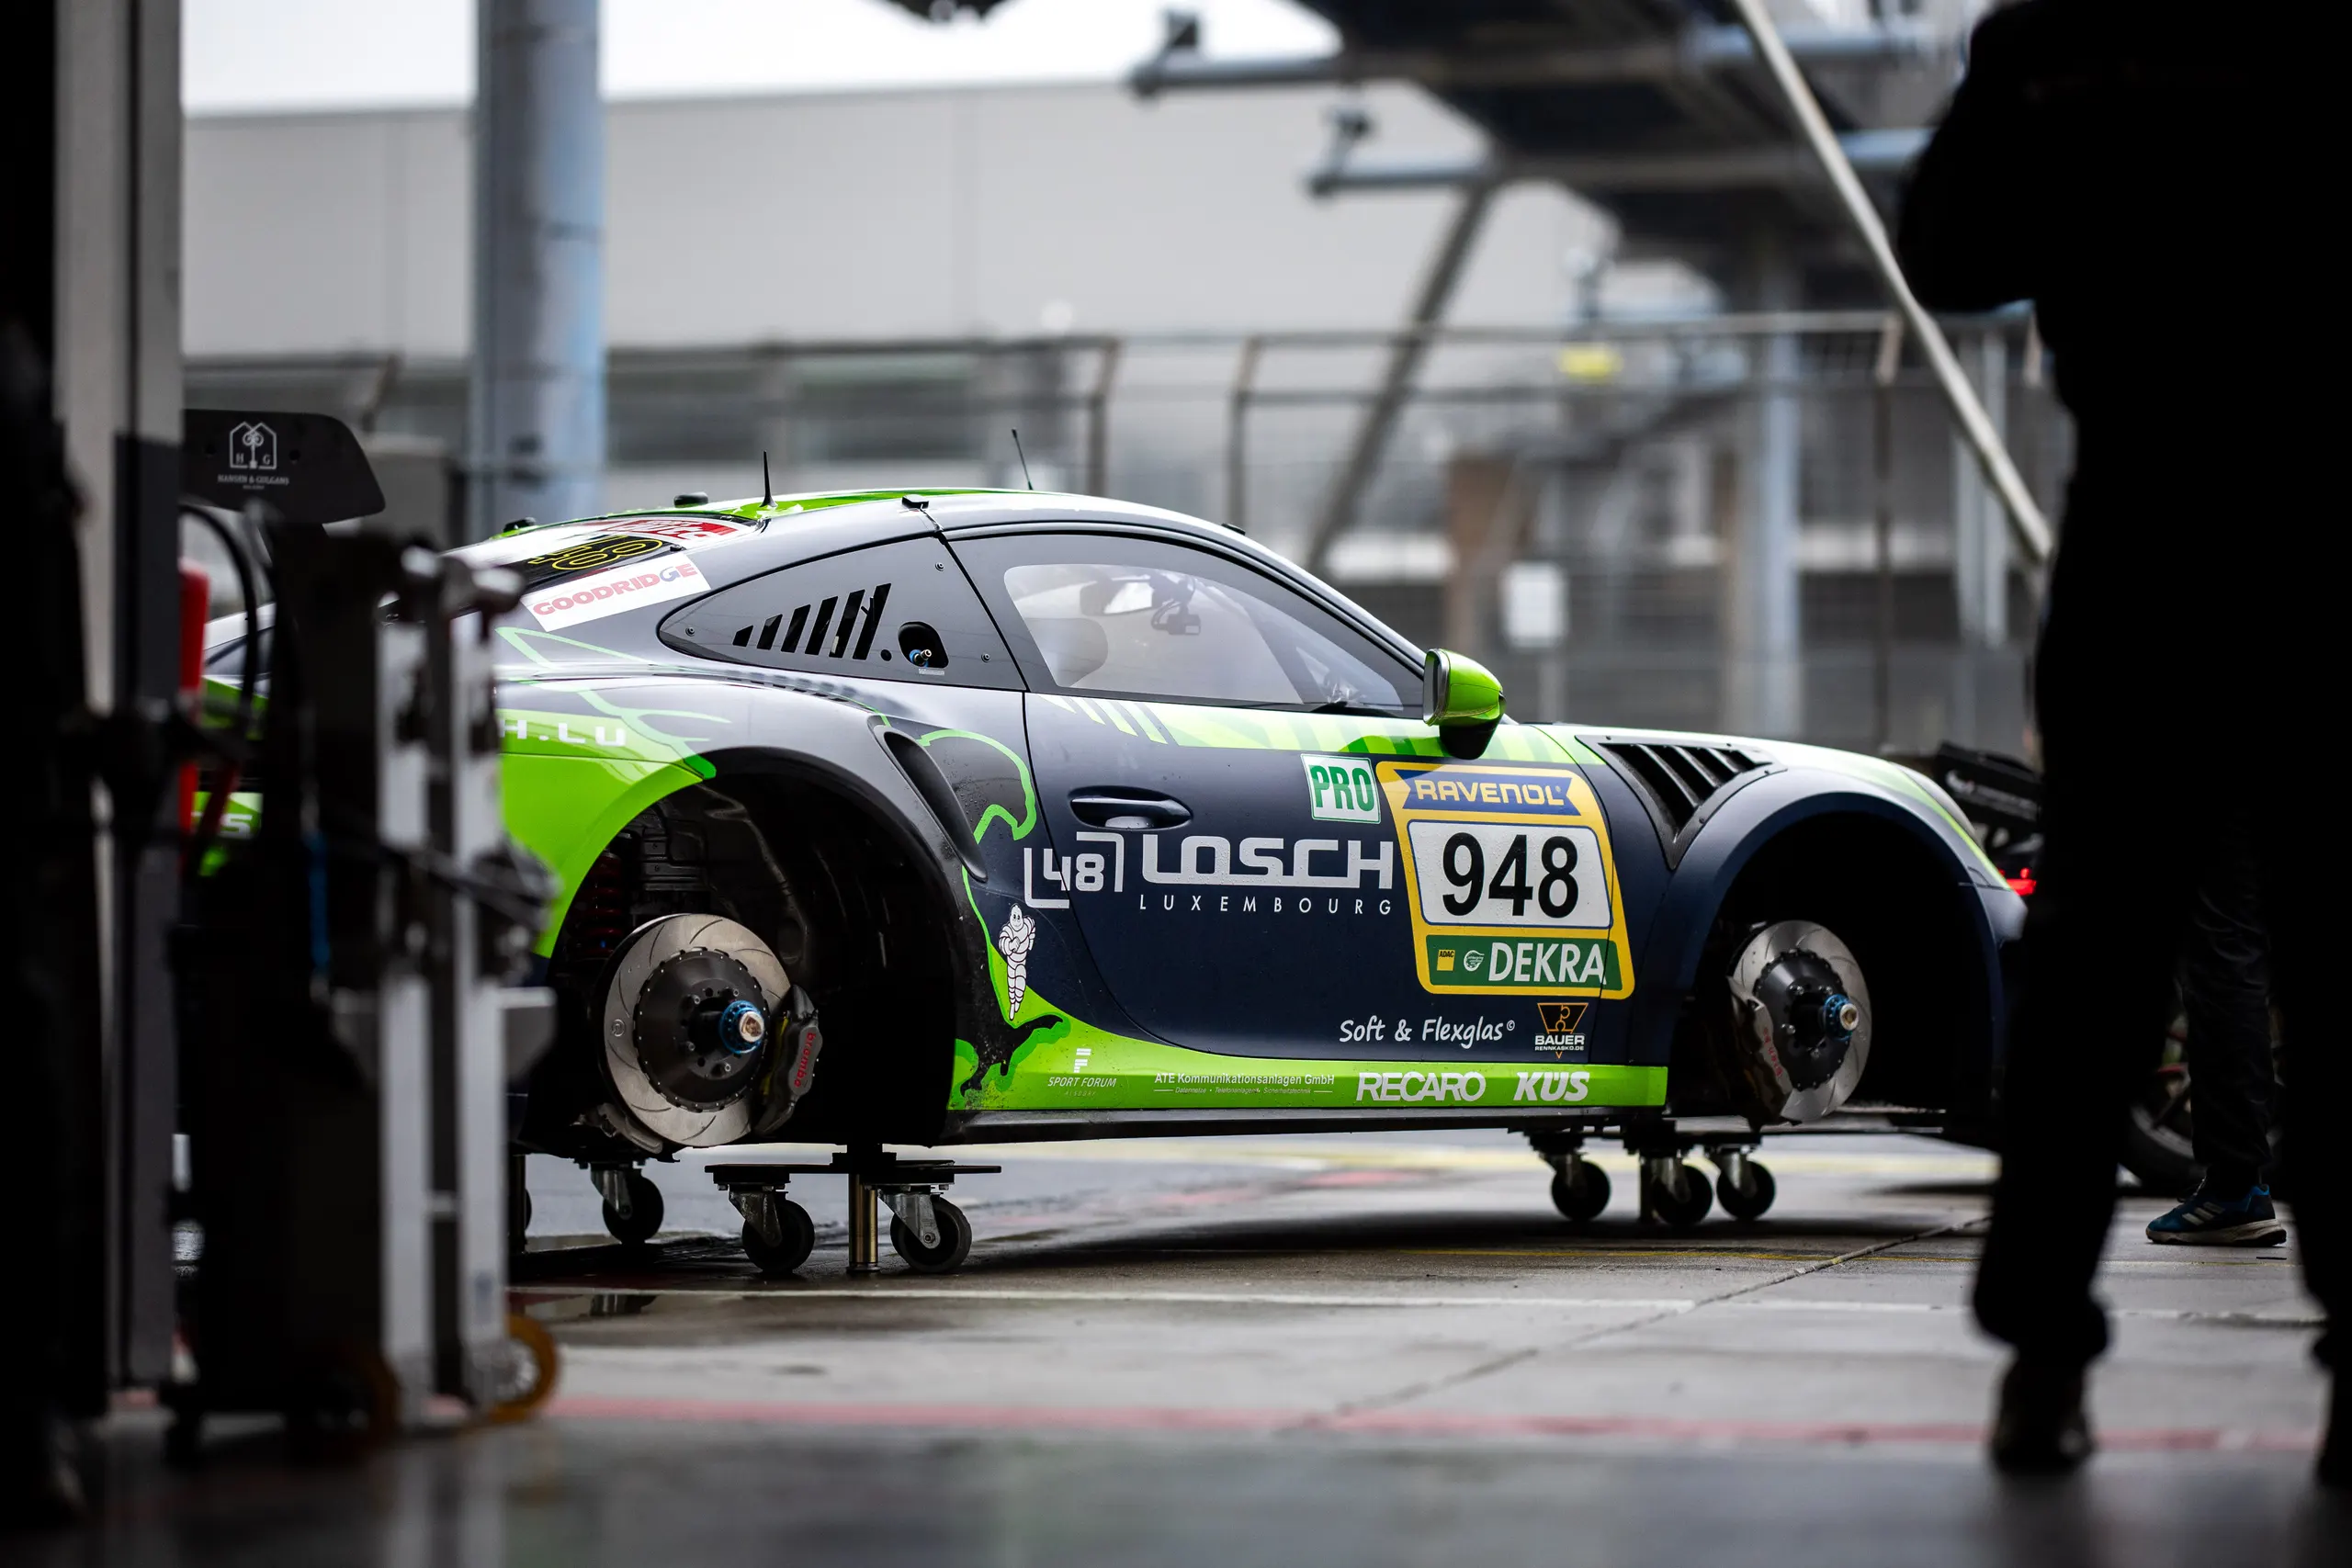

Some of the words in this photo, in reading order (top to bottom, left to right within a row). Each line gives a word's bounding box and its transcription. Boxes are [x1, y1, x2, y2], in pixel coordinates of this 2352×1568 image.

[532, 563, 698, 615] GOODRIDGE
[1307, 764, 1375, 812] PRO
[1142, 833, 1394, 889] LOSCH
[1442, 831, 1578, 919] 948
[1140, 894, 1391, 916] LUXEMBOURG
[1487, 942, 1607, 986] DEKRA
[1339, 1015, 1385, 1043] Soft
[1394, 1019, 1412, 1042] &
[1534, 1034, 1585, 1045] BAUER
[794, 1032, 817, 1088] brembo
[1047, 1077, 1080, 1087] SPORT
[1080, 1077, 1117, 1088] FORUM
[1154, 1073, 1175, 1084] ATE
[1177, 1073, 1302, 1086] Kommunikationsanlagen
[1304, 1074, 1335, 1085] GmbH
[1356, 1071, 1487, 1101] RECARO
[1512, 1071, 1590, 1101] KÜS
